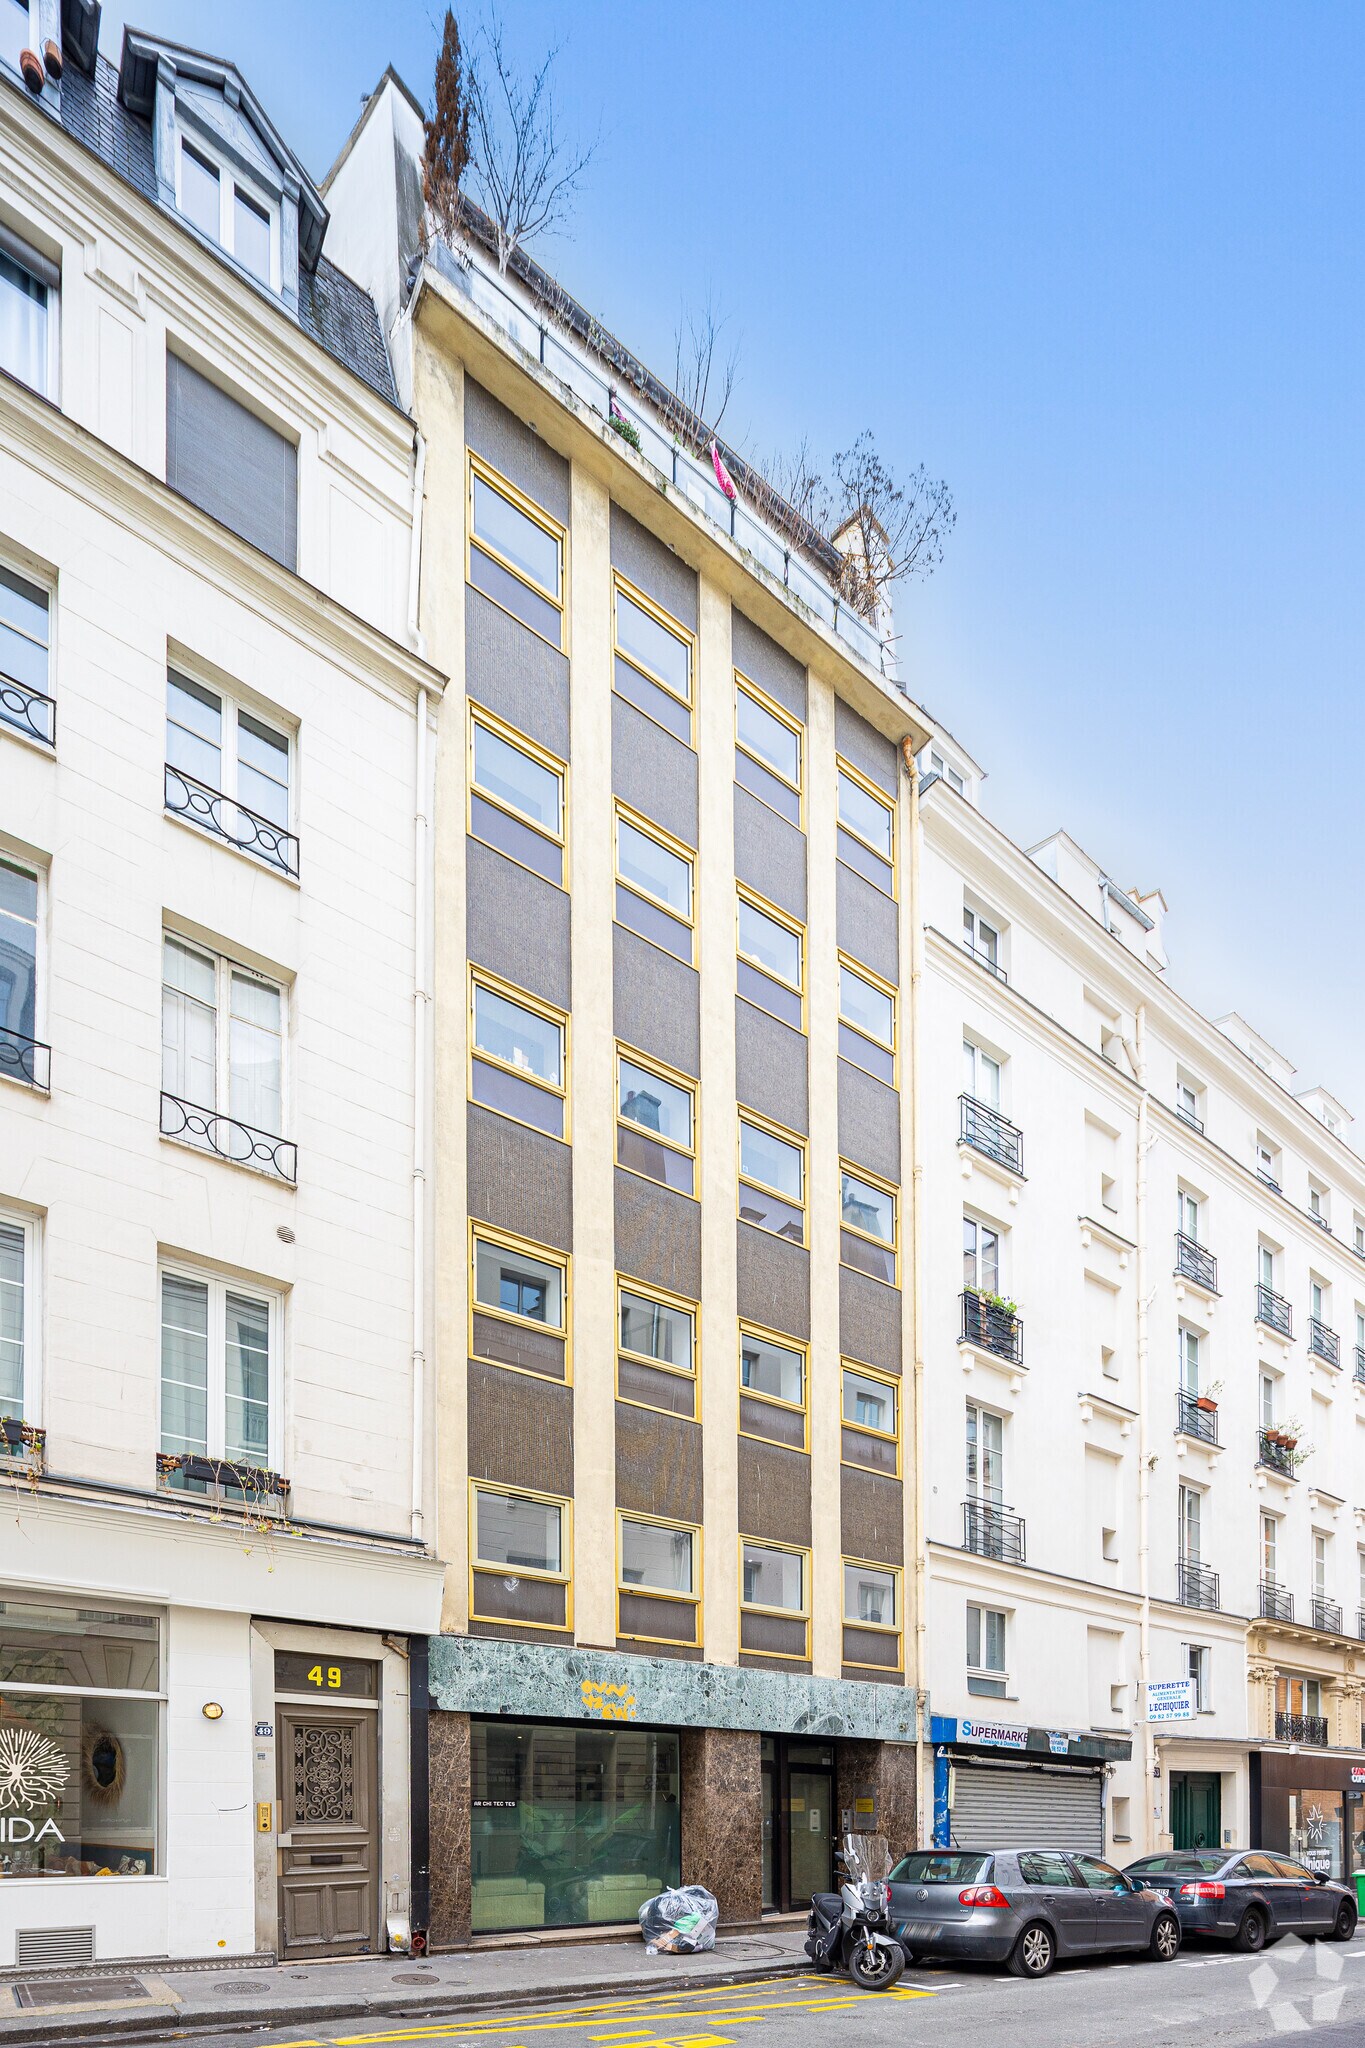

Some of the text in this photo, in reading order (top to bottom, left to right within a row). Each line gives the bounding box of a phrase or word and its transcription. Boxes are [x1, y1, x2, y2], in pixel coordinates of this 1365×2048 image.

[308, 1665, 341, 1688] 49
[1148, 1681, 1190, 1691] SUPERETTE
[1152, 1689, 1187, 1697] ALIMENTATION
[1149, 1700, 1190, 1712] L'ECHIQUIER
[257, 1727, 271, 1735] 49
